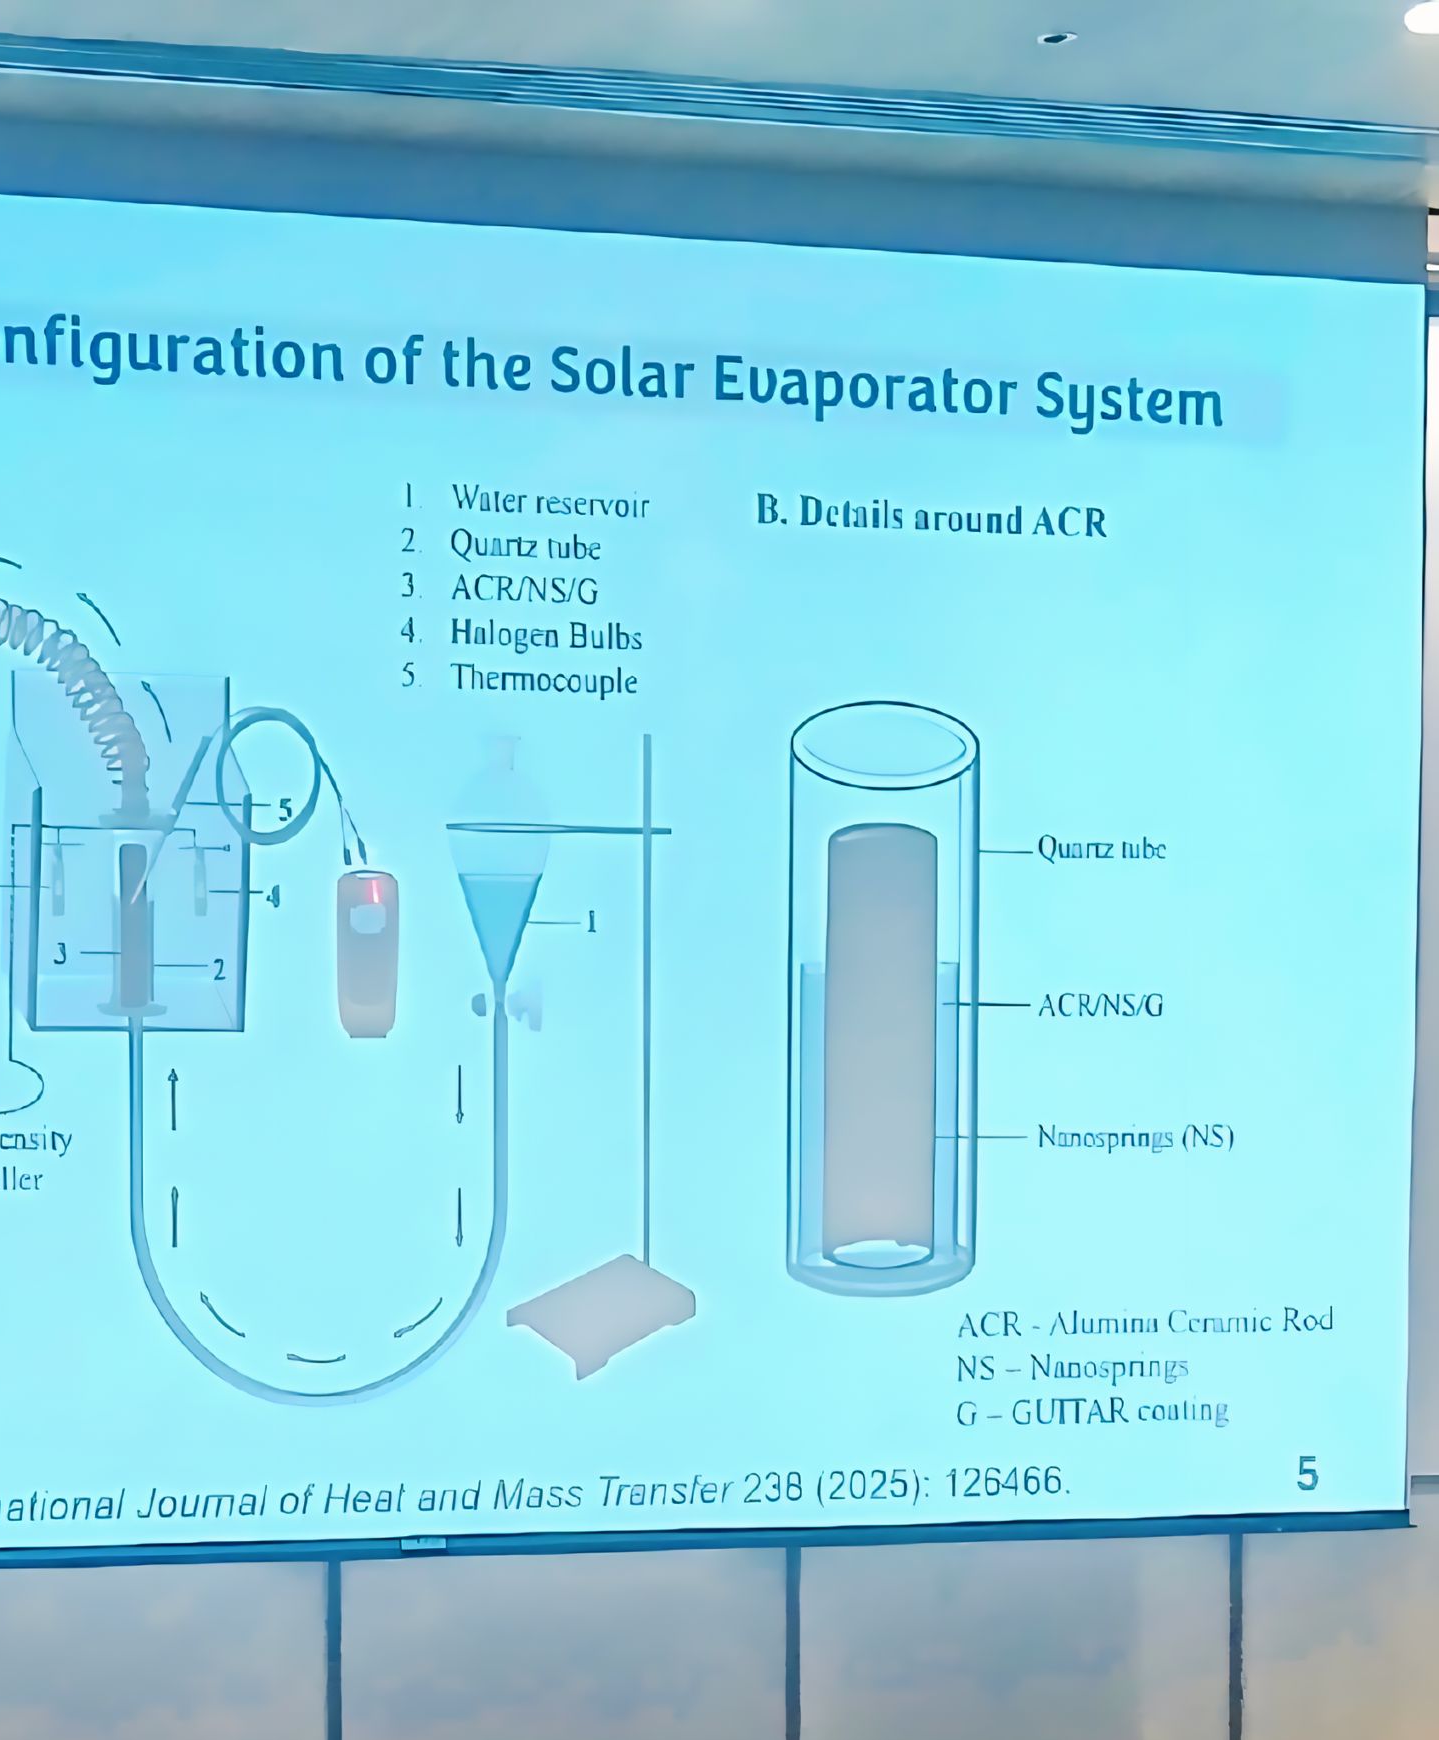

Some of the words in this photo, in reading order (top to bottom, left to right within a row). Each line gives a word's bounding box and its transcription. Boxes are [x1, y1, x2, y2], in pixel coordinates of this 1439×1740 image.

[364, 333, 425, 386] of
[442, 336, 531, 392] the
[550, 344, 696, 399] Solar
[714, 354, 1018, 423] Evaporator
[1035, 371, 1224, 436] System
[451, 483, 528, 514] Water
[536, 491, 650, 519] reservoir
[756, 492, 788, 526] B.
[799, 494, 903, 530] Details
[914, 505, 1023, 535] around
[1031, 505, 1108, 538] ACR
[450, 527, 538, 563] Quartz
[547, 533, 602, 561] tube
[451, 573, 599, 606] ACR/NS/G
[451, 617, 559, 655] Halogen
[568, 621, 643, 650] Bulbs
[449, 662, 638, 701] Thermocouple
[278, 797, 293, 822] 5
[1037, 833, 1115, 865] Quartz
[1121, 835, 1167, 860] tube
[53, 942, 67, 966] 3
[213, 958, 227, 981] 2
[1038, 992, 1163, 1018] ACR/NS/G
[1037, 1123, 1174, 1155] Nanosprings
[1181, 1123, 1235, 1153] (NS)
[957, 1310, 1022, 1339] ACR
[1282, 1305, 1334, 1333] Rod
[957, 1354, 995, 1383] NS
[1030, 1353, 1189, 1388] Nanosprings
[956, 1400, 978, 1427] G
[1296, 1455, 1320, 1491] 5
[136, 1484, 268, 1519] Journal
[279, 1482, 316, 1515] of
[323, 1482, 406, 1515] Heat
[417, 1479, 482, 1512] and
[493, 1477, 584, 1511] Mass
[599, 1474, 735, 1507] Transfer
[743, 1471, 803, 1504] 238
[816, 1468, 930, 1509] (2025):
[945, 1465, 1071, 1498] 126466.
